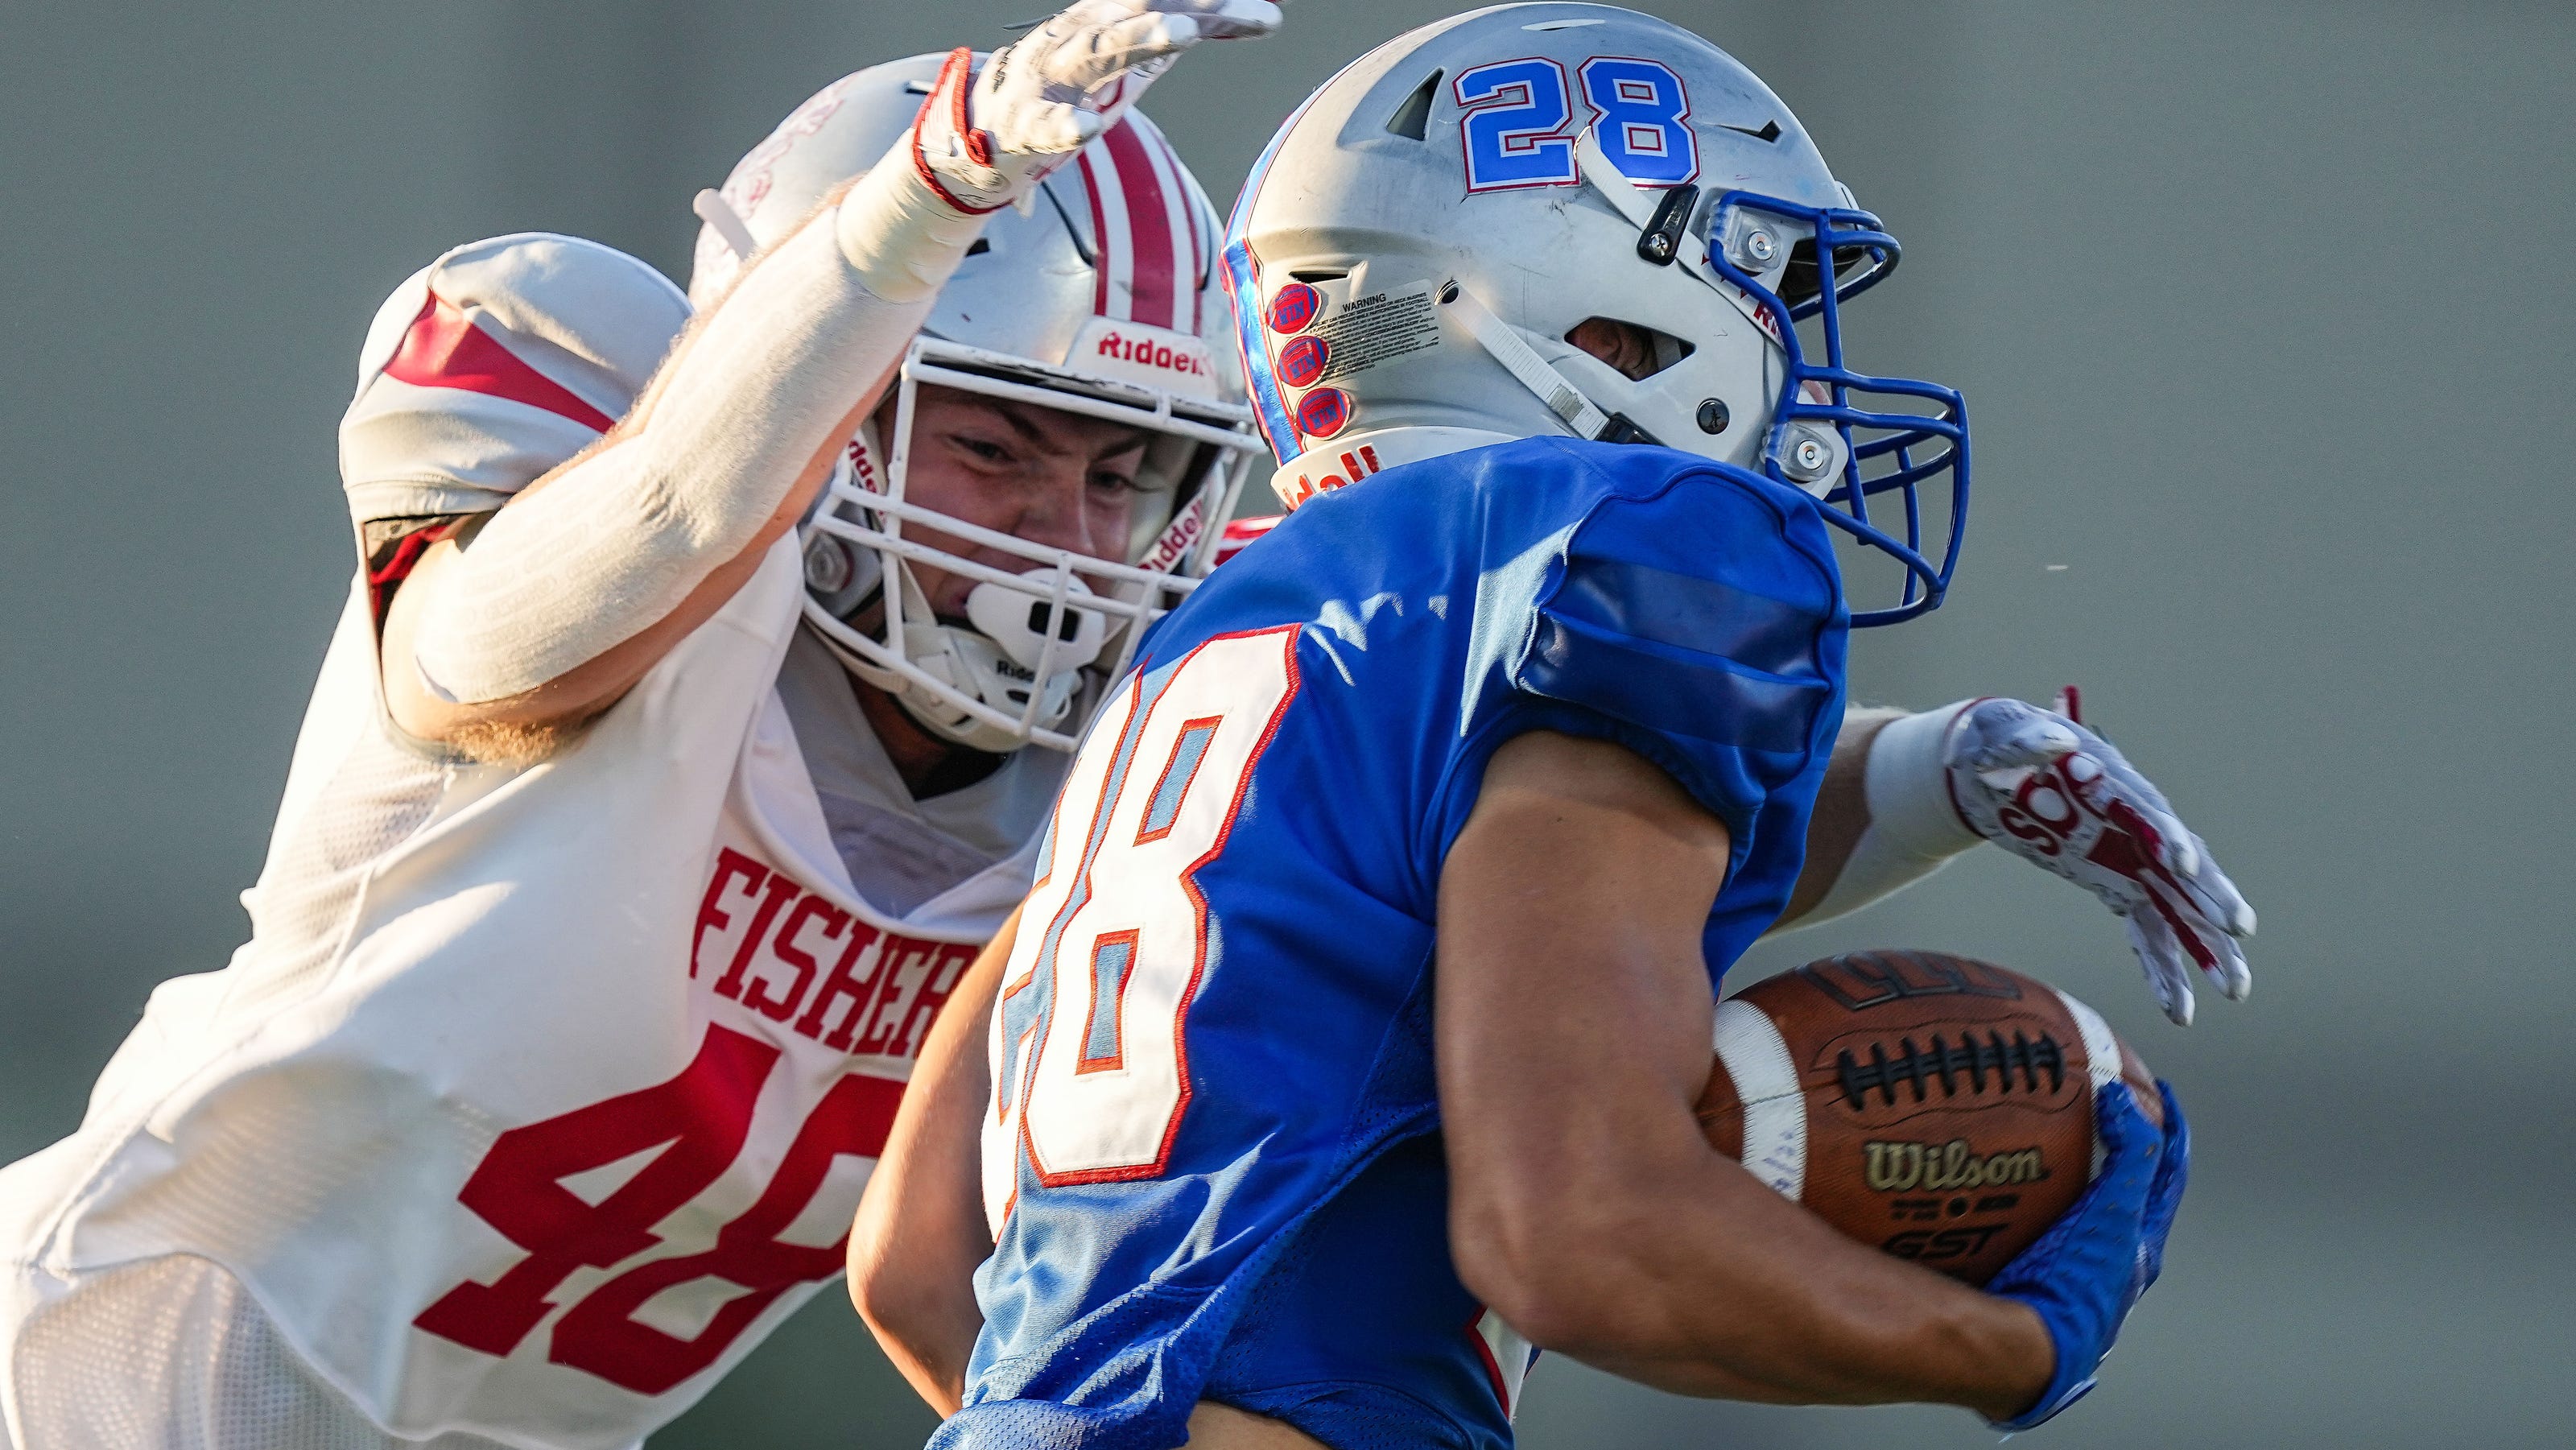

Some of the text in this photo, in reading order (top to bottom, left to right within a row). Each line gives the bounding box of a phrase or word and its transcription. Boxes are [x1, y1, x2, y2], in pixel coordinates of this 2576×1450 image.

[1452, 56, 1700, 193] 28
[1278, 300, 1305, 326] WIN
[1342, 294, 1386, 312] WARNING
[1289, 353, 1317, 379] WIN
[1309, 404, 1338, 430] WIN
[690, 846, 980, 1060] FISHER
[1865, 1138, 2046, 1192] Wilson
[412, 1022, 908, 1396] 48
[1881, 1222, 2011, 1260] GST
